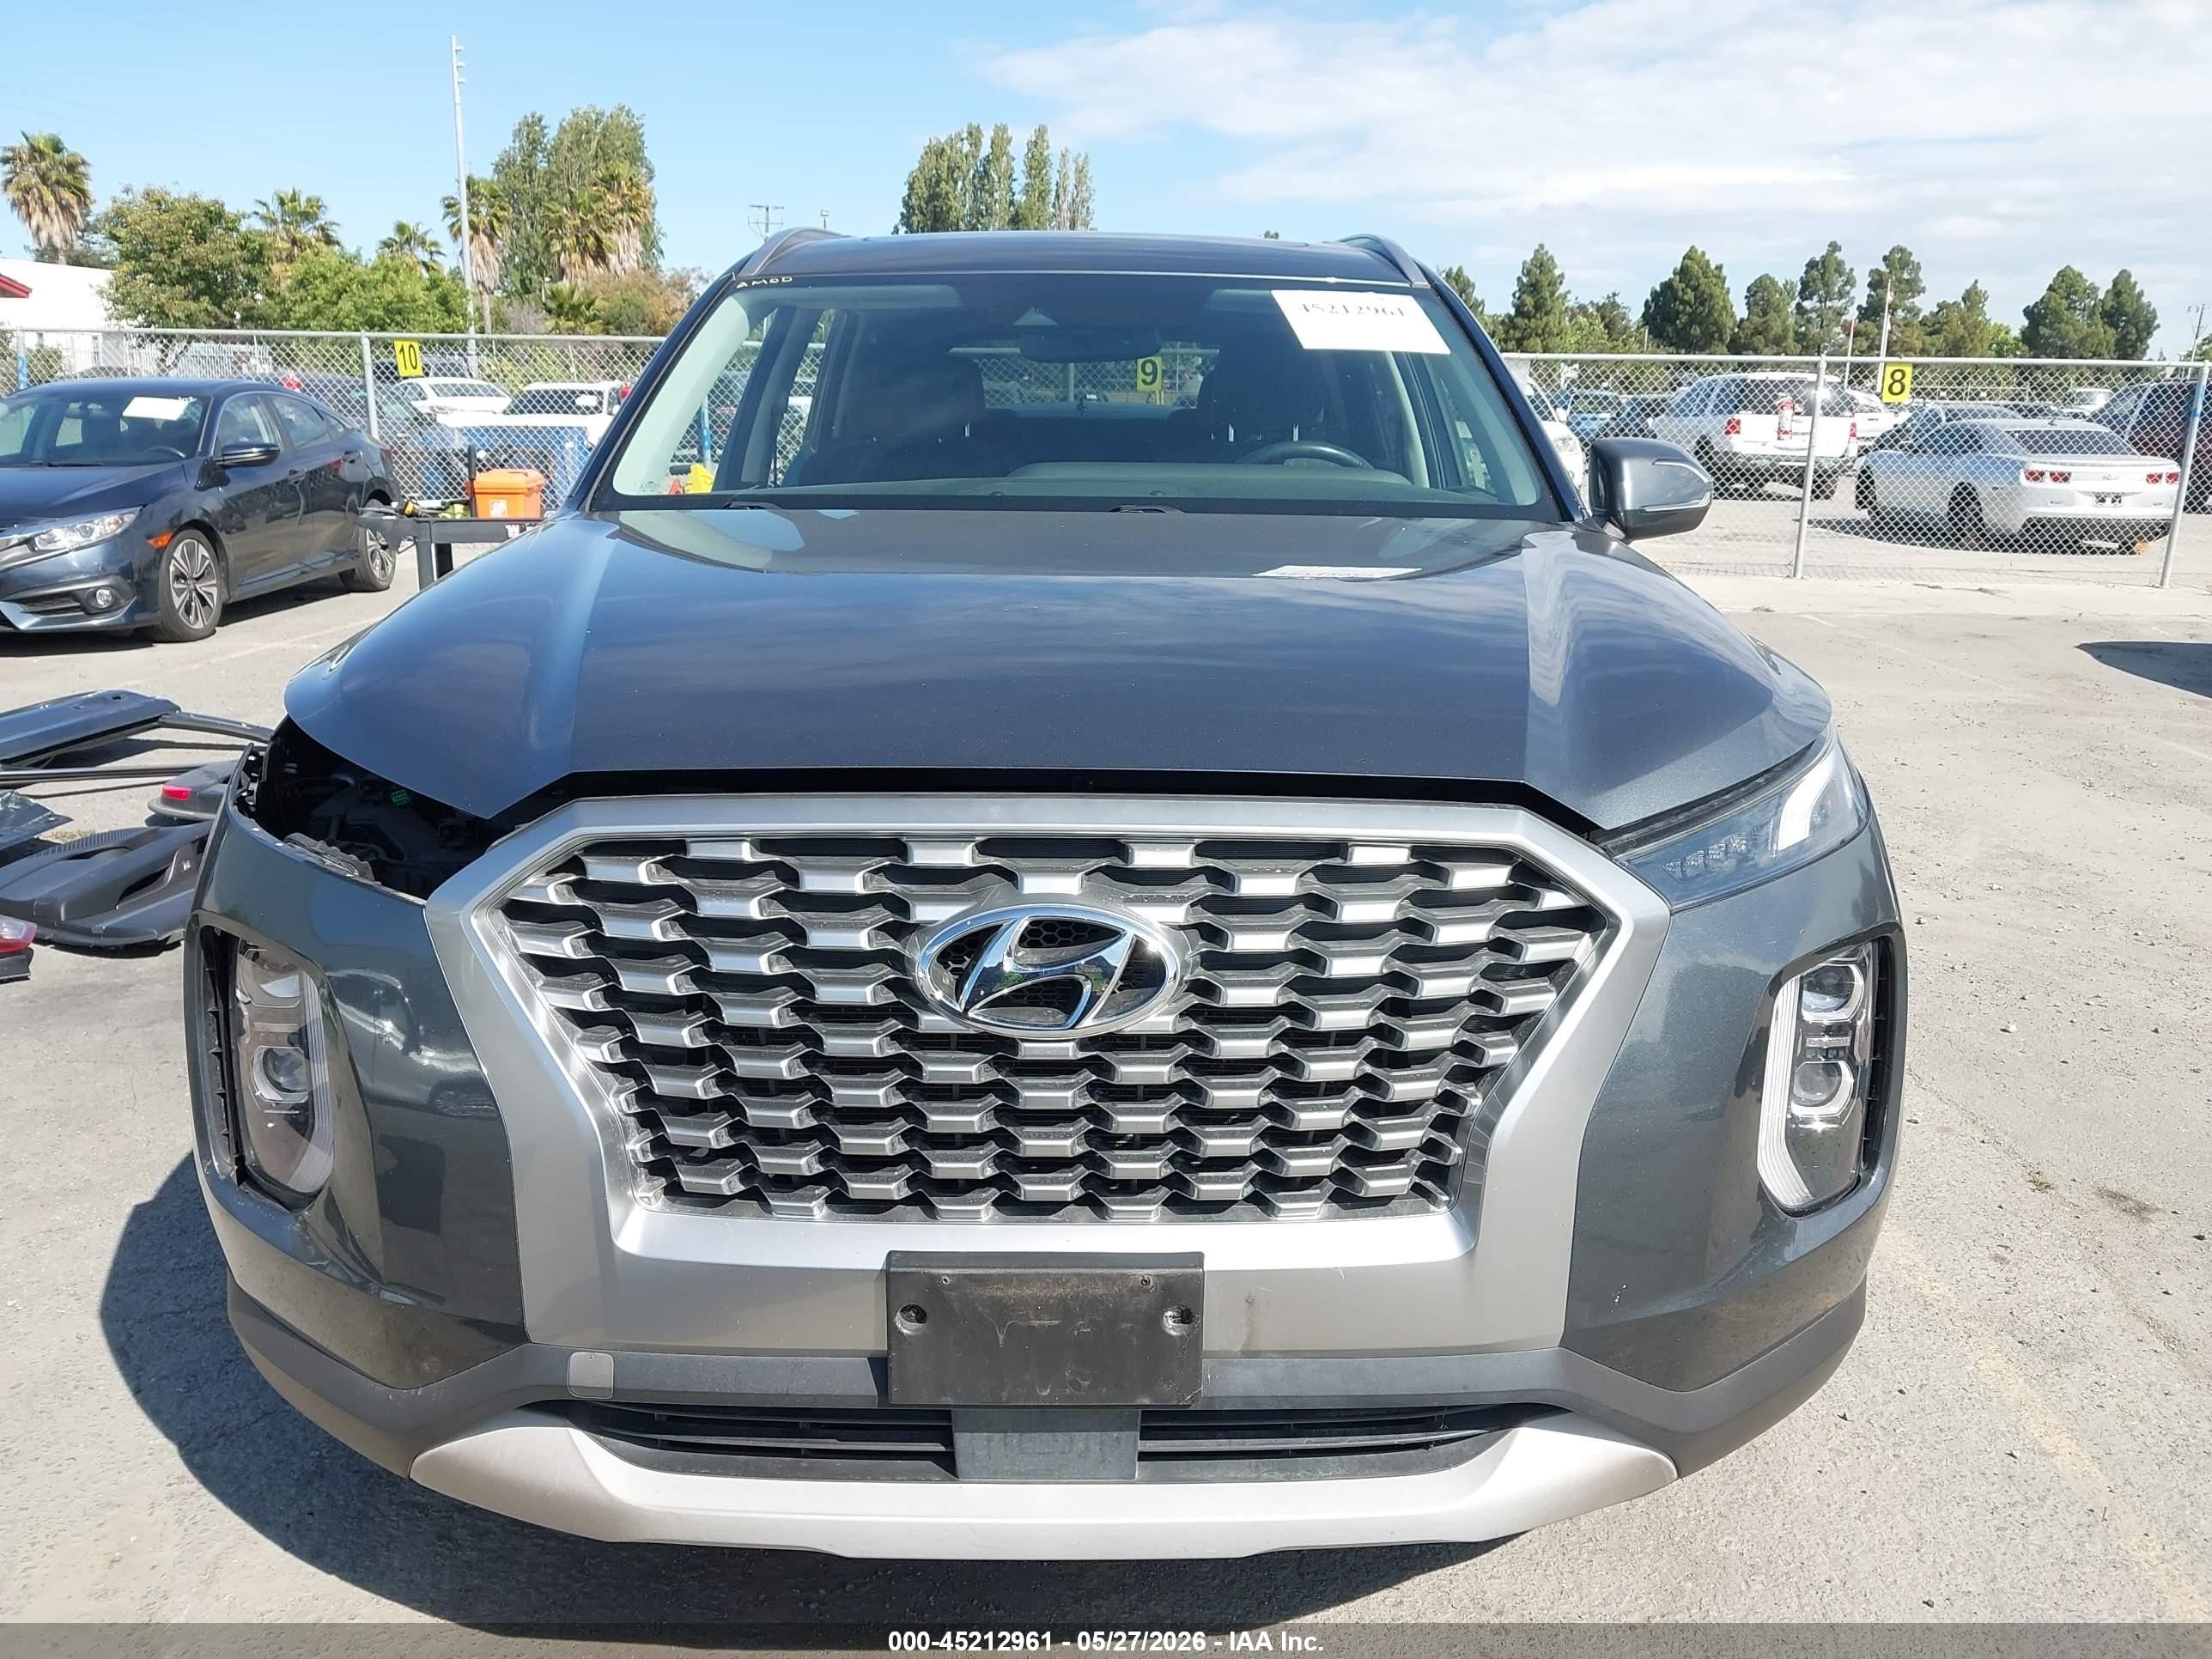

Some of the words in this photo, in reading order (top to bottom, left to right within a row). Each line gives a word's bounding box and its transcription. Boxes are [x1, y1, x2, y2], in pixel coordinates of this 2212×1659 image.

[398, 343, 417, 370] 10
[1140, 359, 1158, 386] 9
[1887, 368, 1906, 396] 8
